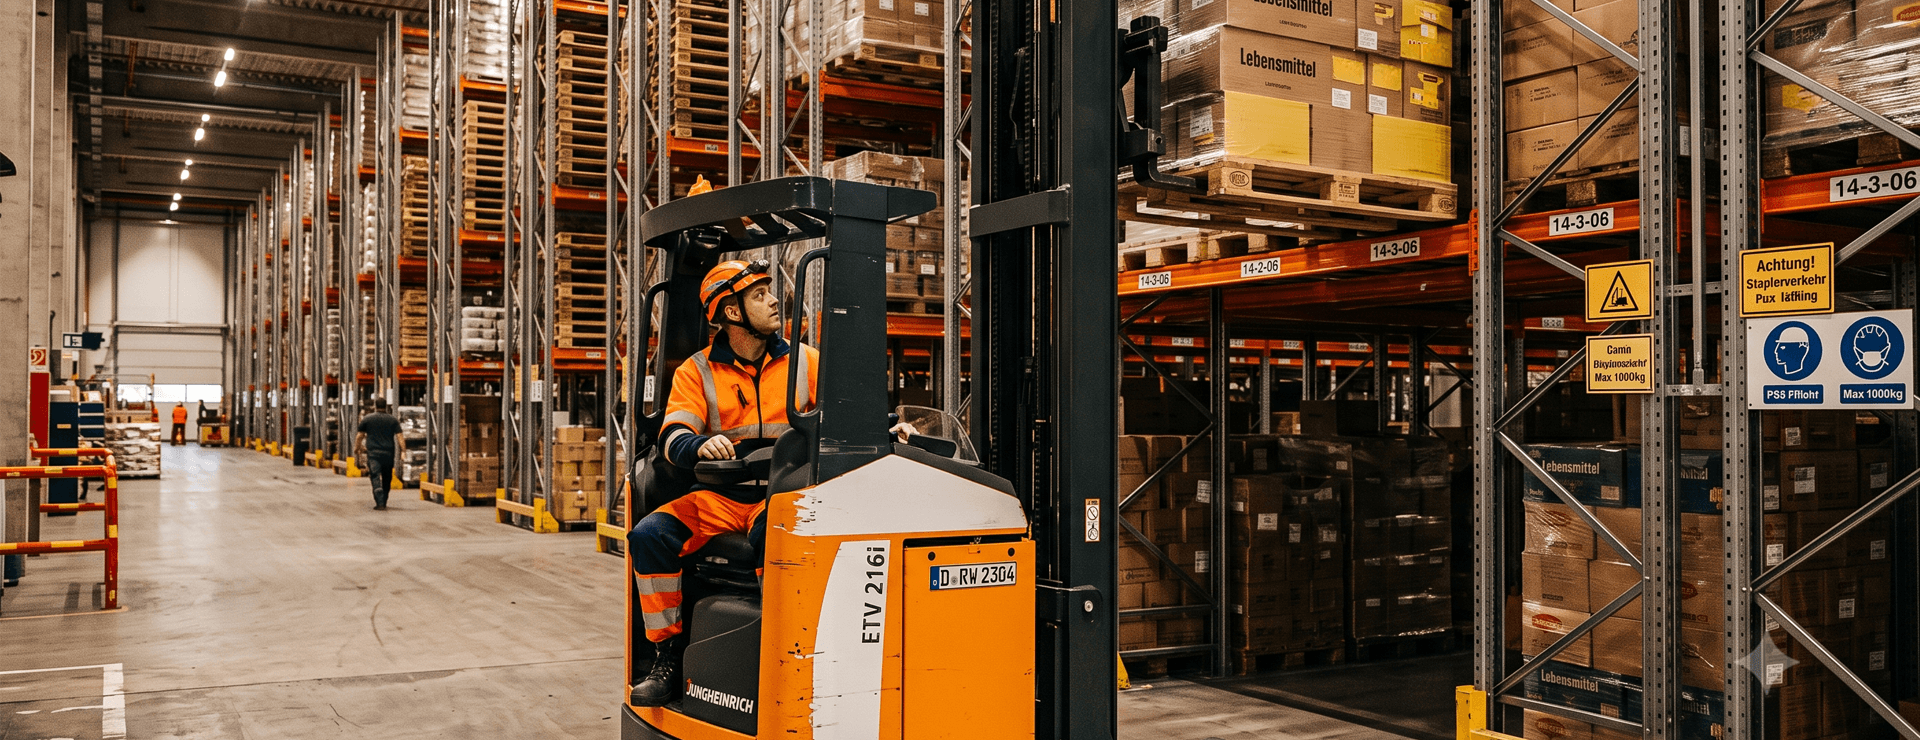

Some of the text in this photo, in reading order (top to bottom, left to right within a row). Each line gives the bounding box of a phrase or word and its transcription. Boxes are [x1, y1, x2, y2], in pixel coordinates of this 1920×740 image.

[1240, 47, 1316, 78] Lebensmittel
[1835, 171, 1918, 198] 14-3-06
[1553, 210, 1609, 233] 14-3-06
[1373, 240, 1418, 258] 14-3-06
[1243, 259, 1279, 275] 14-2-06
[1756, 255, 1815, 272] Achtung!
[1140, 273, 1169, 286] 14-3-06
[1746, 274, 1826, 291] Staplerverkehr
[1594, 372, 1646, 384] Max 1000kg
[1843, 389, 1903, 400] Max 1000kg
[940, 569, 950, 587] D
[960, 567, 978, 585] RW
[981, 565, 1014, 583] 2304
[861, 547, 885, 643] ETV 216i
[1541, 668, 1599, 693] Lebensmittel
[686, 681, 754, 714] JUNGHEINRICH
